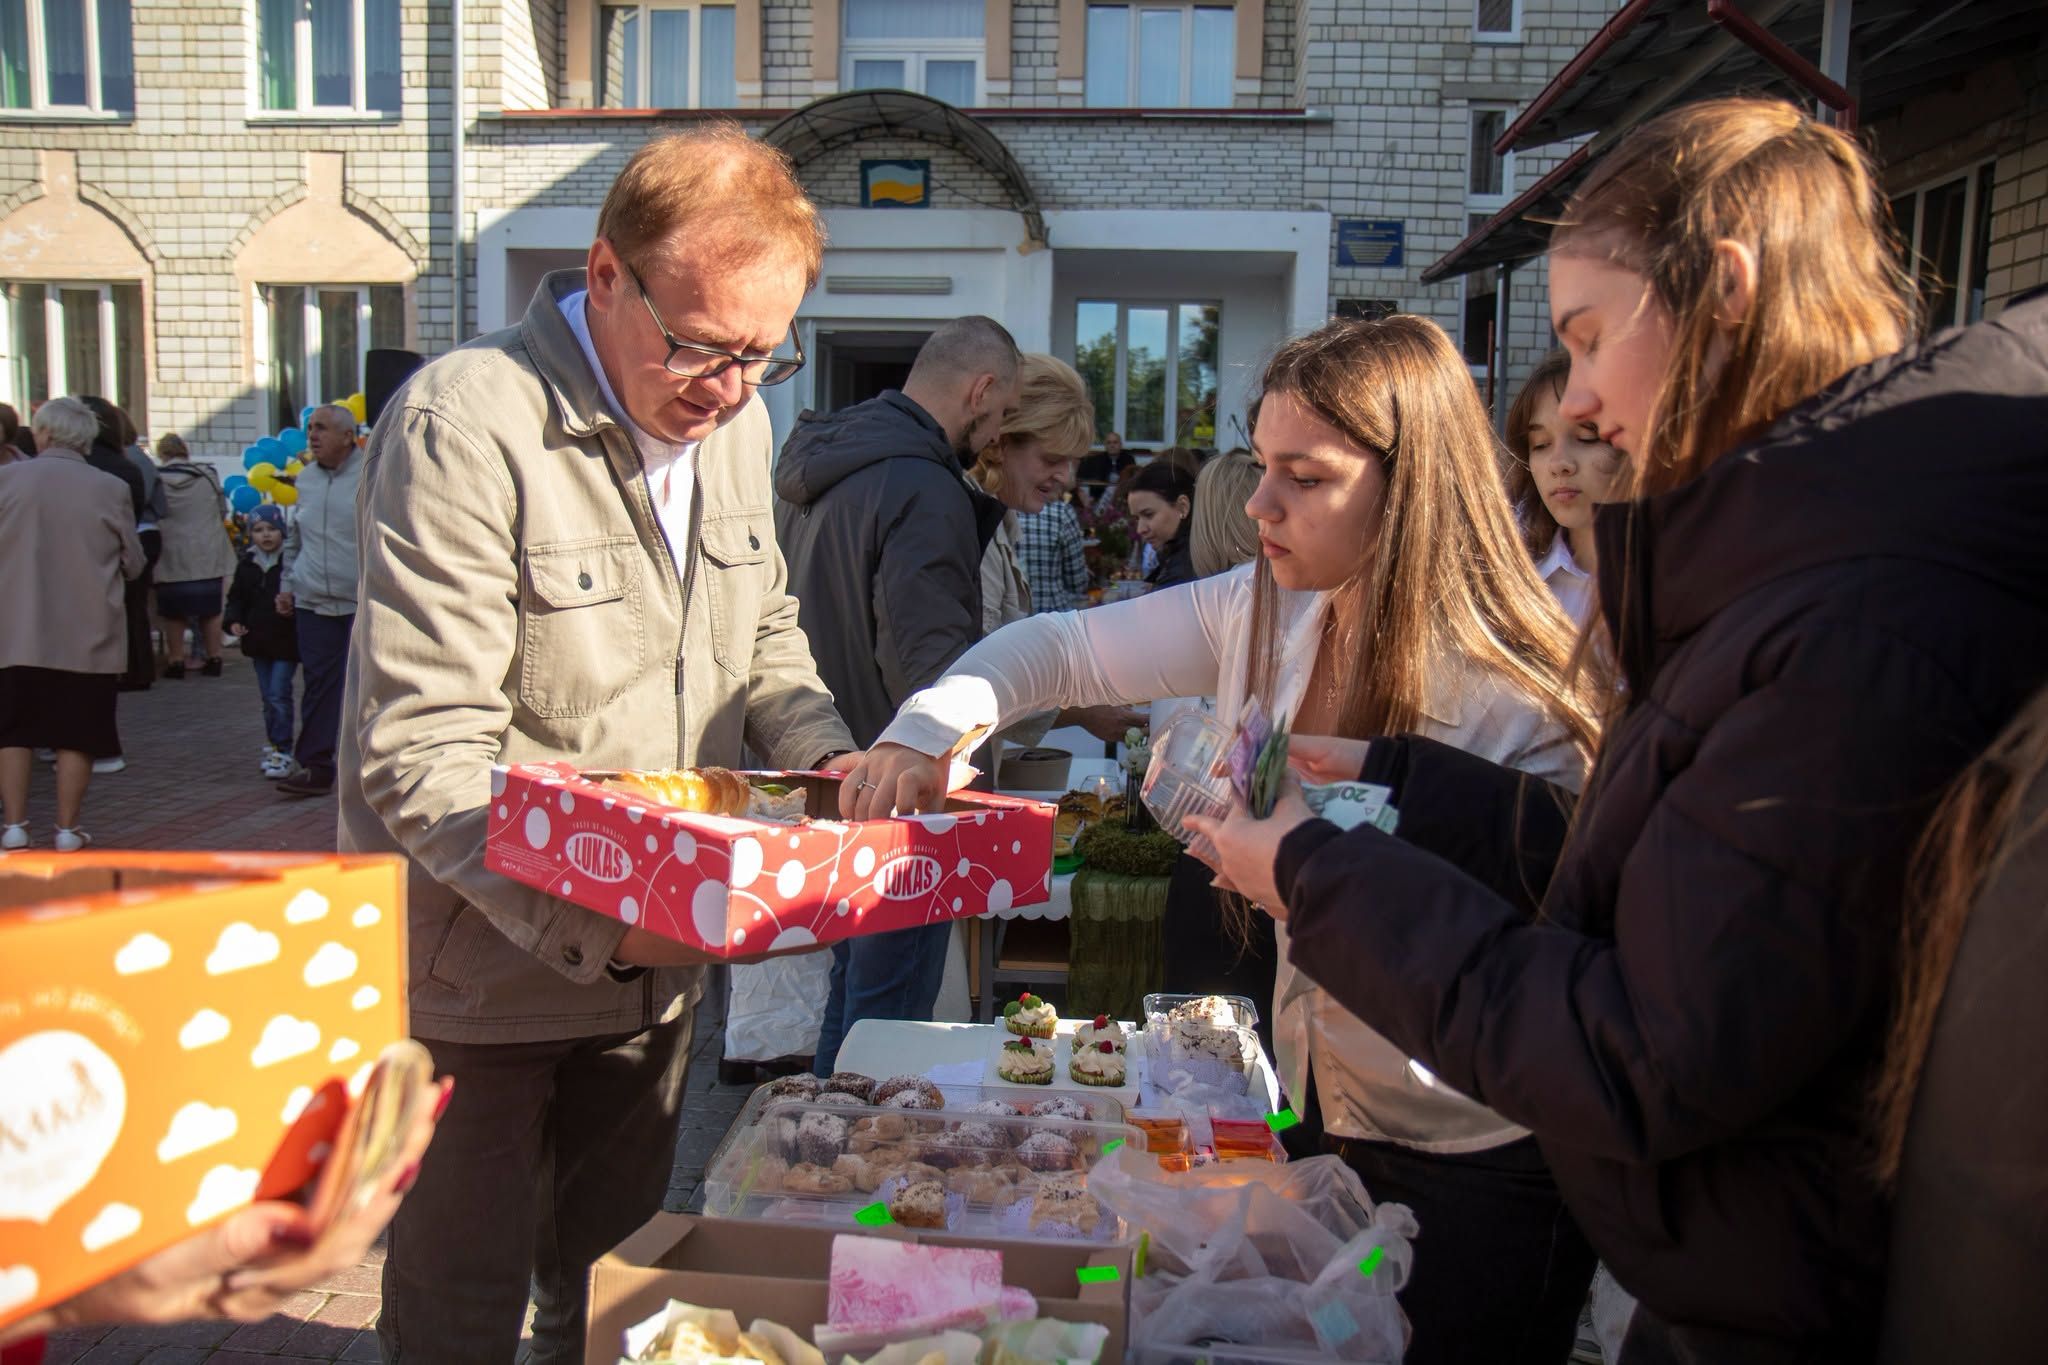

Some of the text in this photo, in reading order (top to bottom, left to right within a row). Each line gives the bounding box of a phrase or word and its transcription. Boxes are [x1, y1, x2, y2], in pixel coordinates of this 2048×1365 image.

[1341, 785, 1370, 803] 20
[574, 835, 624, 879] LUKAS
[884, 859, 933, 897] LUKAS
